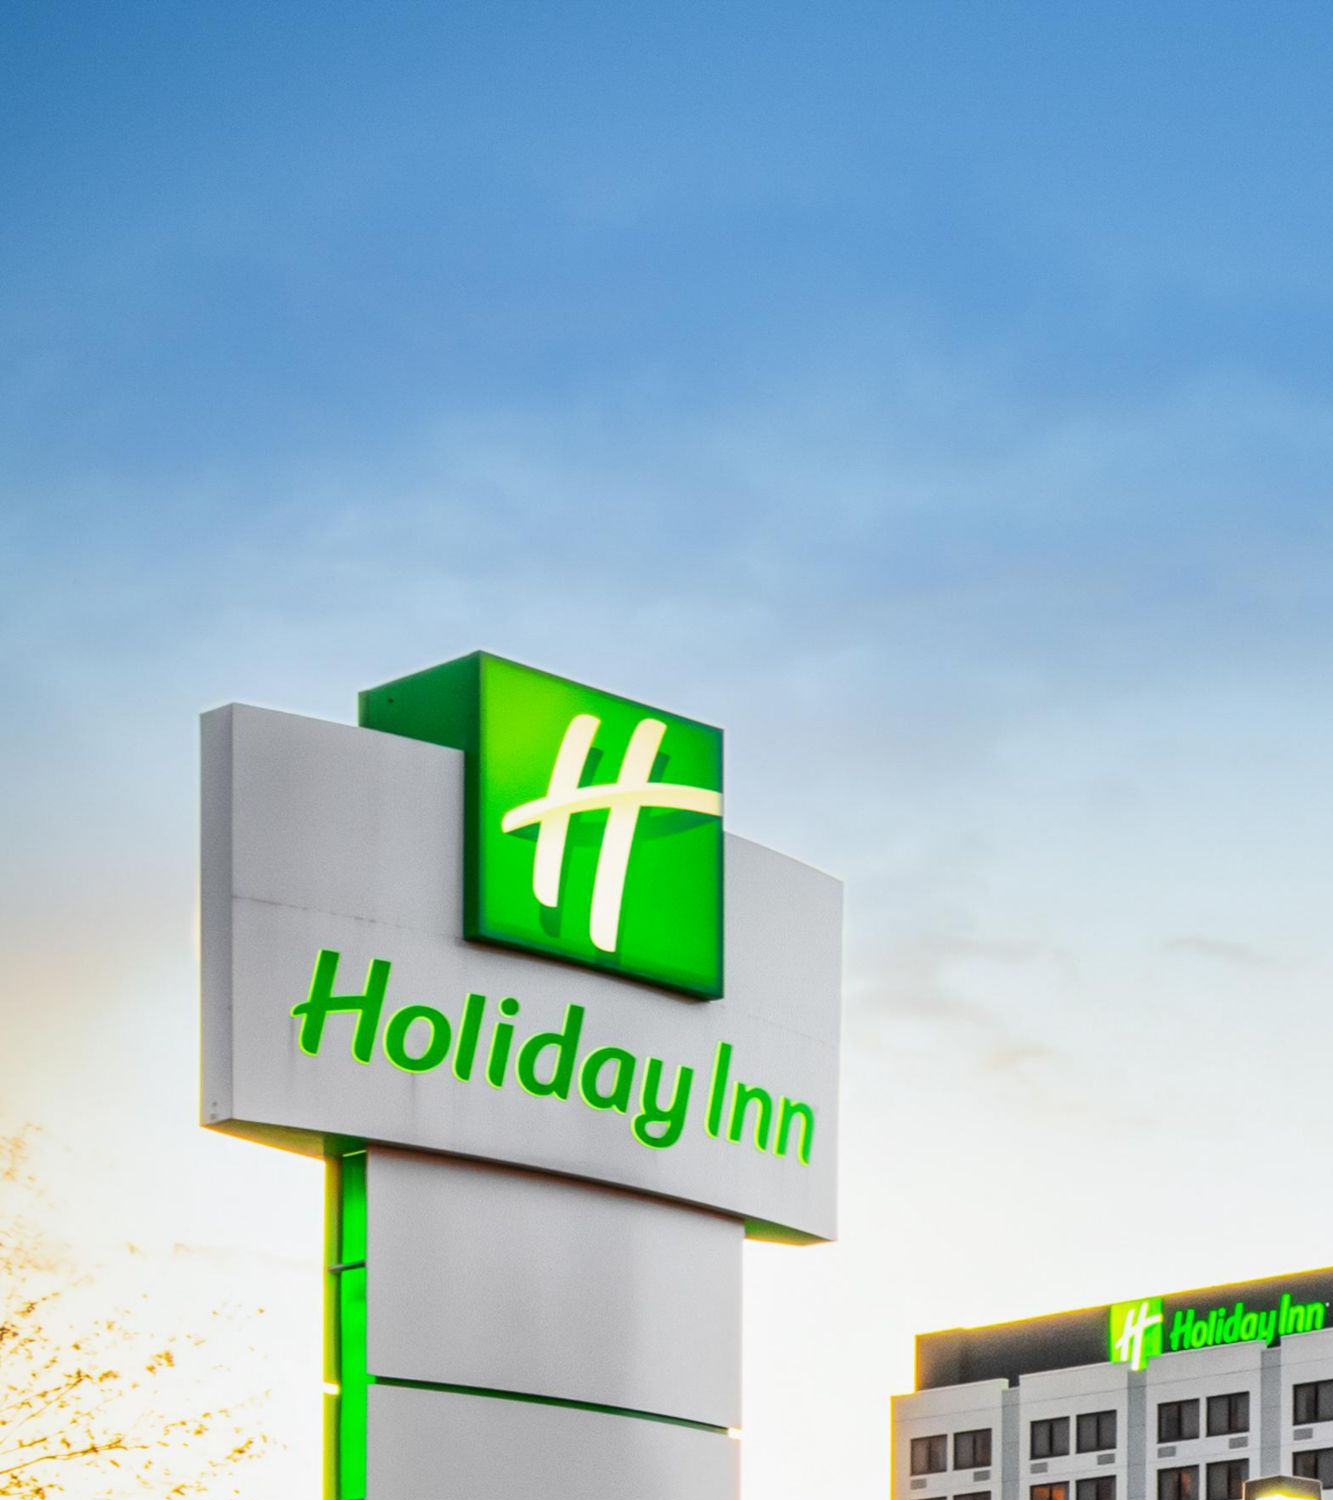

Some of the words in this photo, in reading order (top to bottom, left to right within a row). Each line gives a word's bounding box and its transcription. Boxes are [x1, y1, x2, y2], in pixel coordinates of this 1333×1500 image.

[290, 948, 695, 1150] Holiday
[703, 1040, 815, 1165] Inn
[1169, 1302, 1277, 1350] Holiday
[1278, 1293, 1325, 1335] Inn
